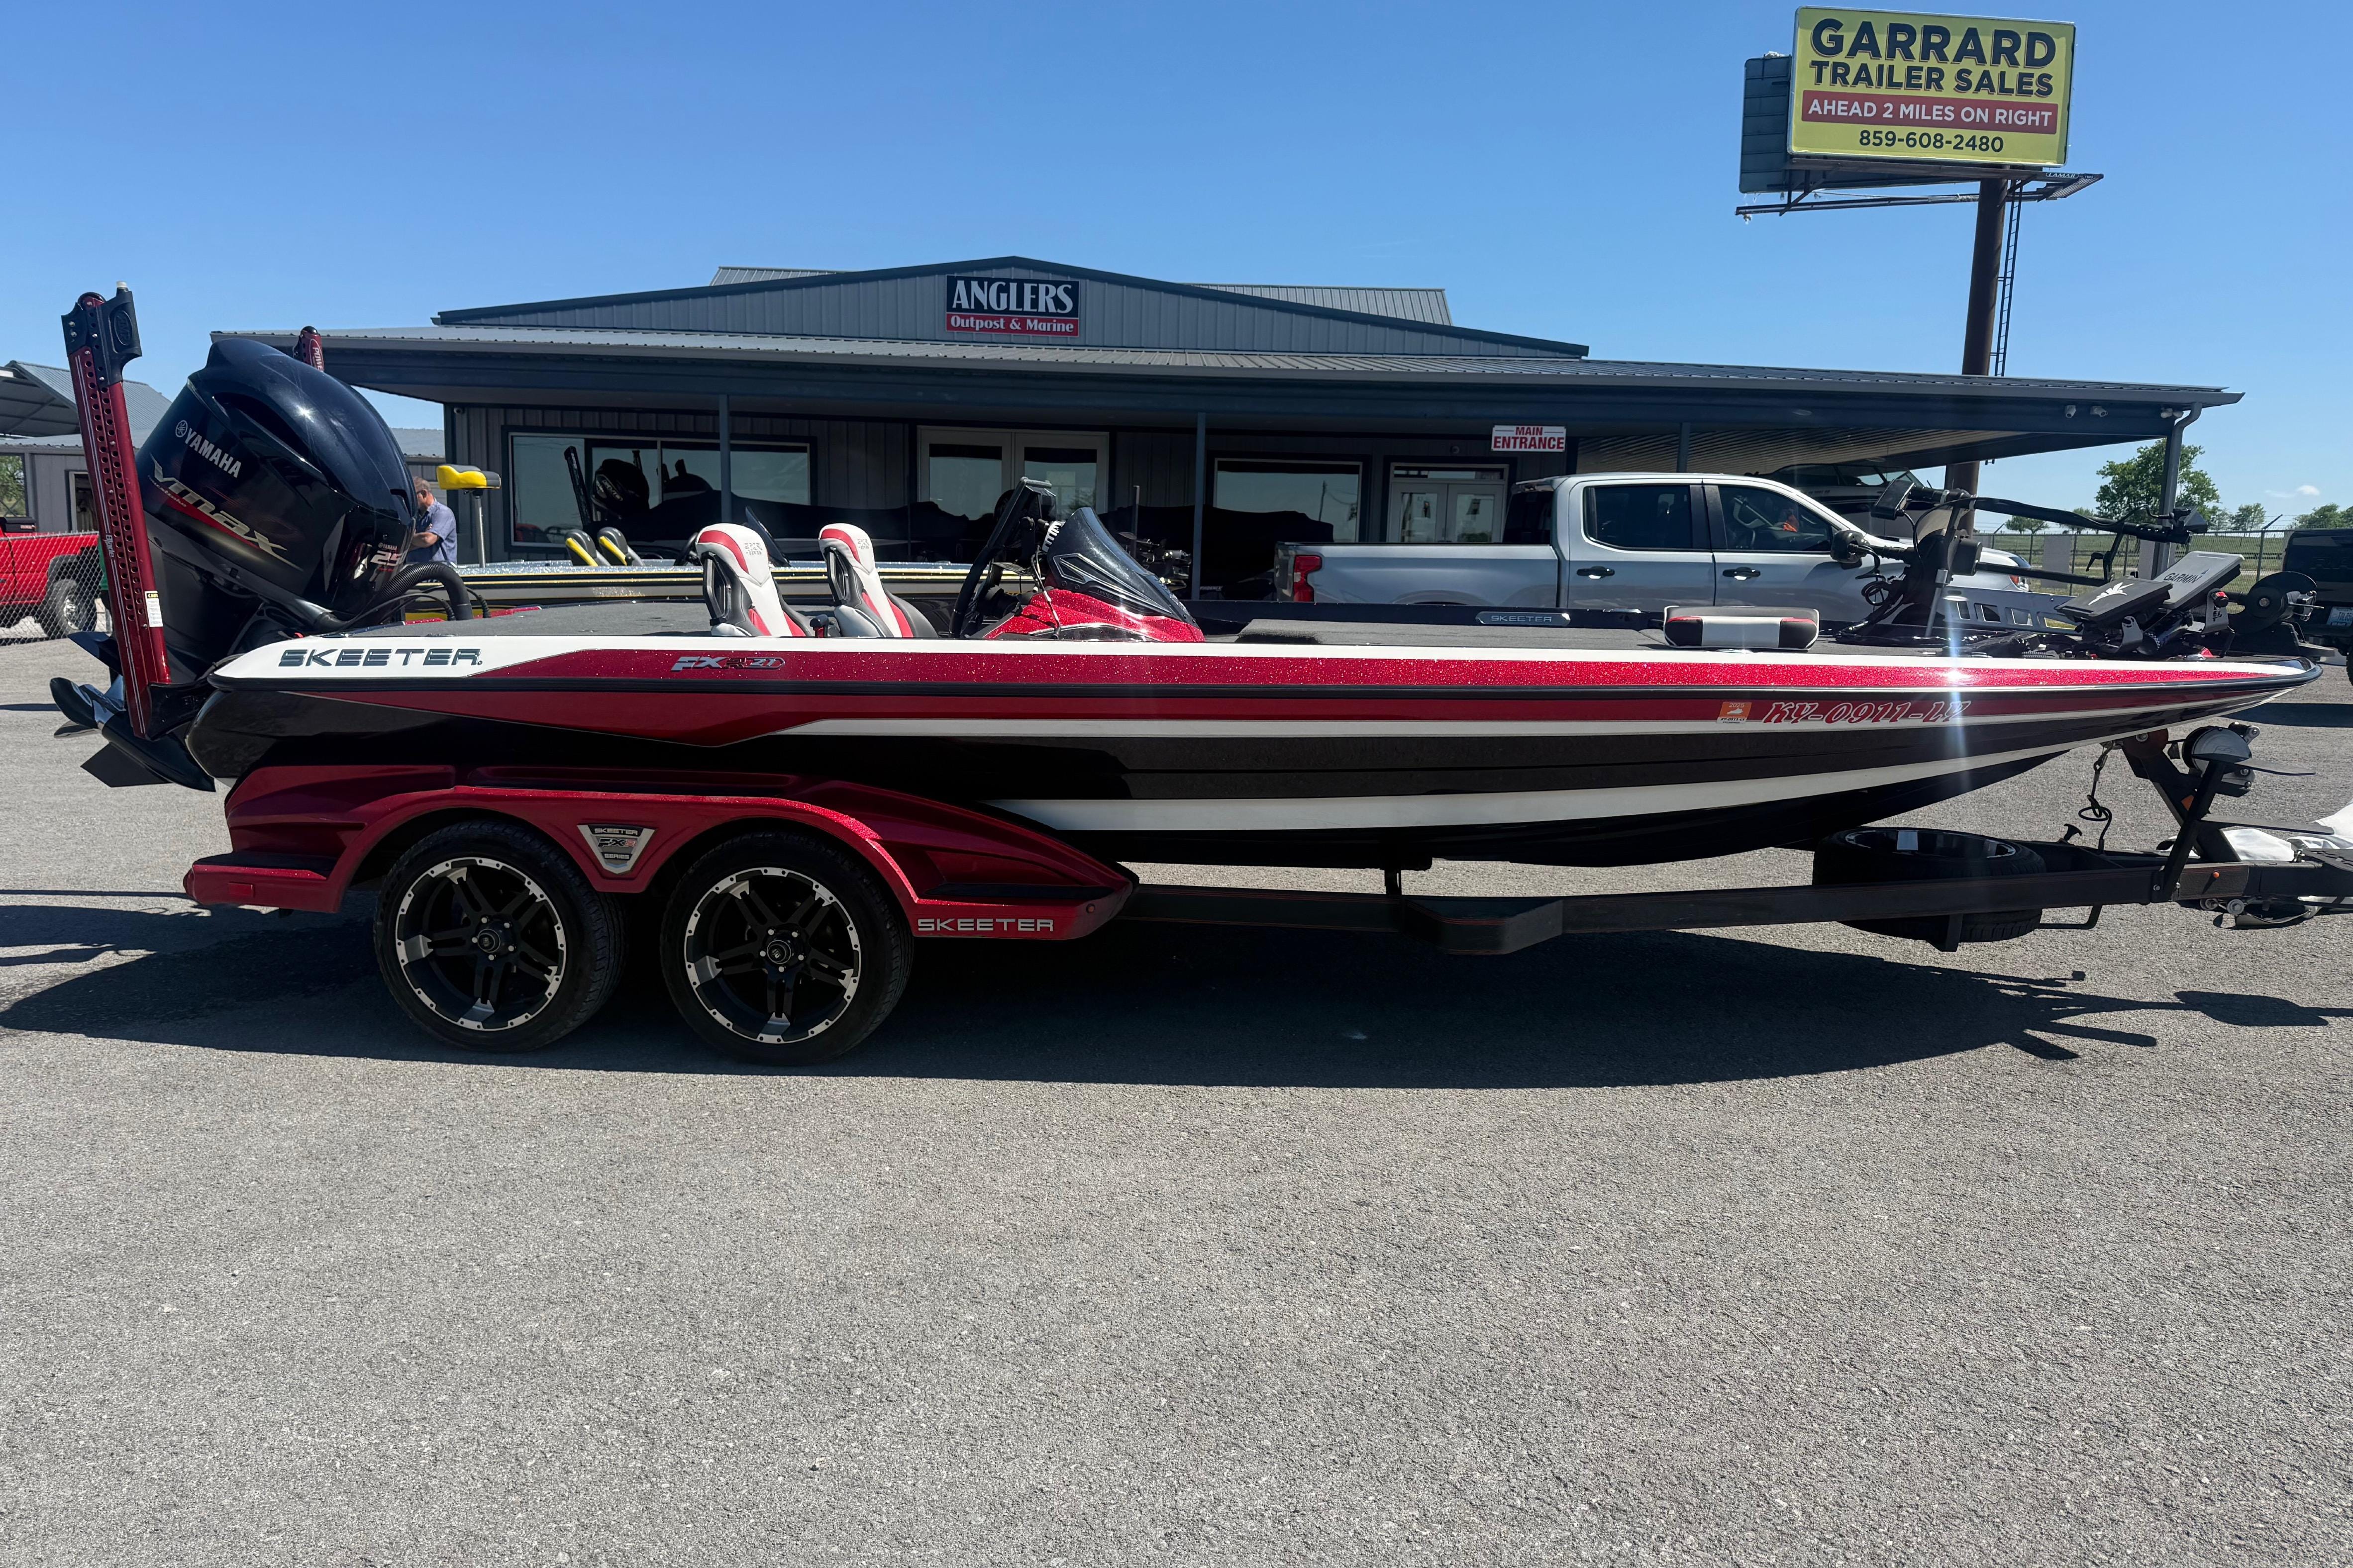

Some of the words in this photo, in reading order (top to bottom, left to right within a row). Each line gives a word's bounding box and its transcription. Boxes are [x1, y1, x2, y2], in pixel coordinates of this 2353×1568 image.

[1811, 18, 2056, 68] GARRARD
[1810, 61, 1944, 91] TRAILER
[1953, 68, 2053, 98] SALES
[1808, 99, 1877, 117] AHEAD
[1882, 102, 1893, 118] 2
[1899, 103, 1955, 121] MILES
[1960, 107, 1989, 123] ON
[1995, 108, 2052, 126] RIGHT
[1859, 130, 2004, 153] 859-608-2480
[952, 280, 1073, 313] ANGLERS
[951, 315, 1006, 331] Outpost
[1010, 318, 1022, 330] &
[1026, 319, 1074, 332] Marine
[1515, 427, 1543, 436] MAIN
[184, 427, 242, 478] YAMAHA
[1493, 436, 1564, 450] ENTRANCE
[2163, 572, 2203, 584] GARMIN
[278, 648, 482, 667] SKEETER
[1763, 701, 1972, 724] KY-0911-LY
[598, 837, 637, 847] FXR
[918, 918, 1054, 932] SKEETER
